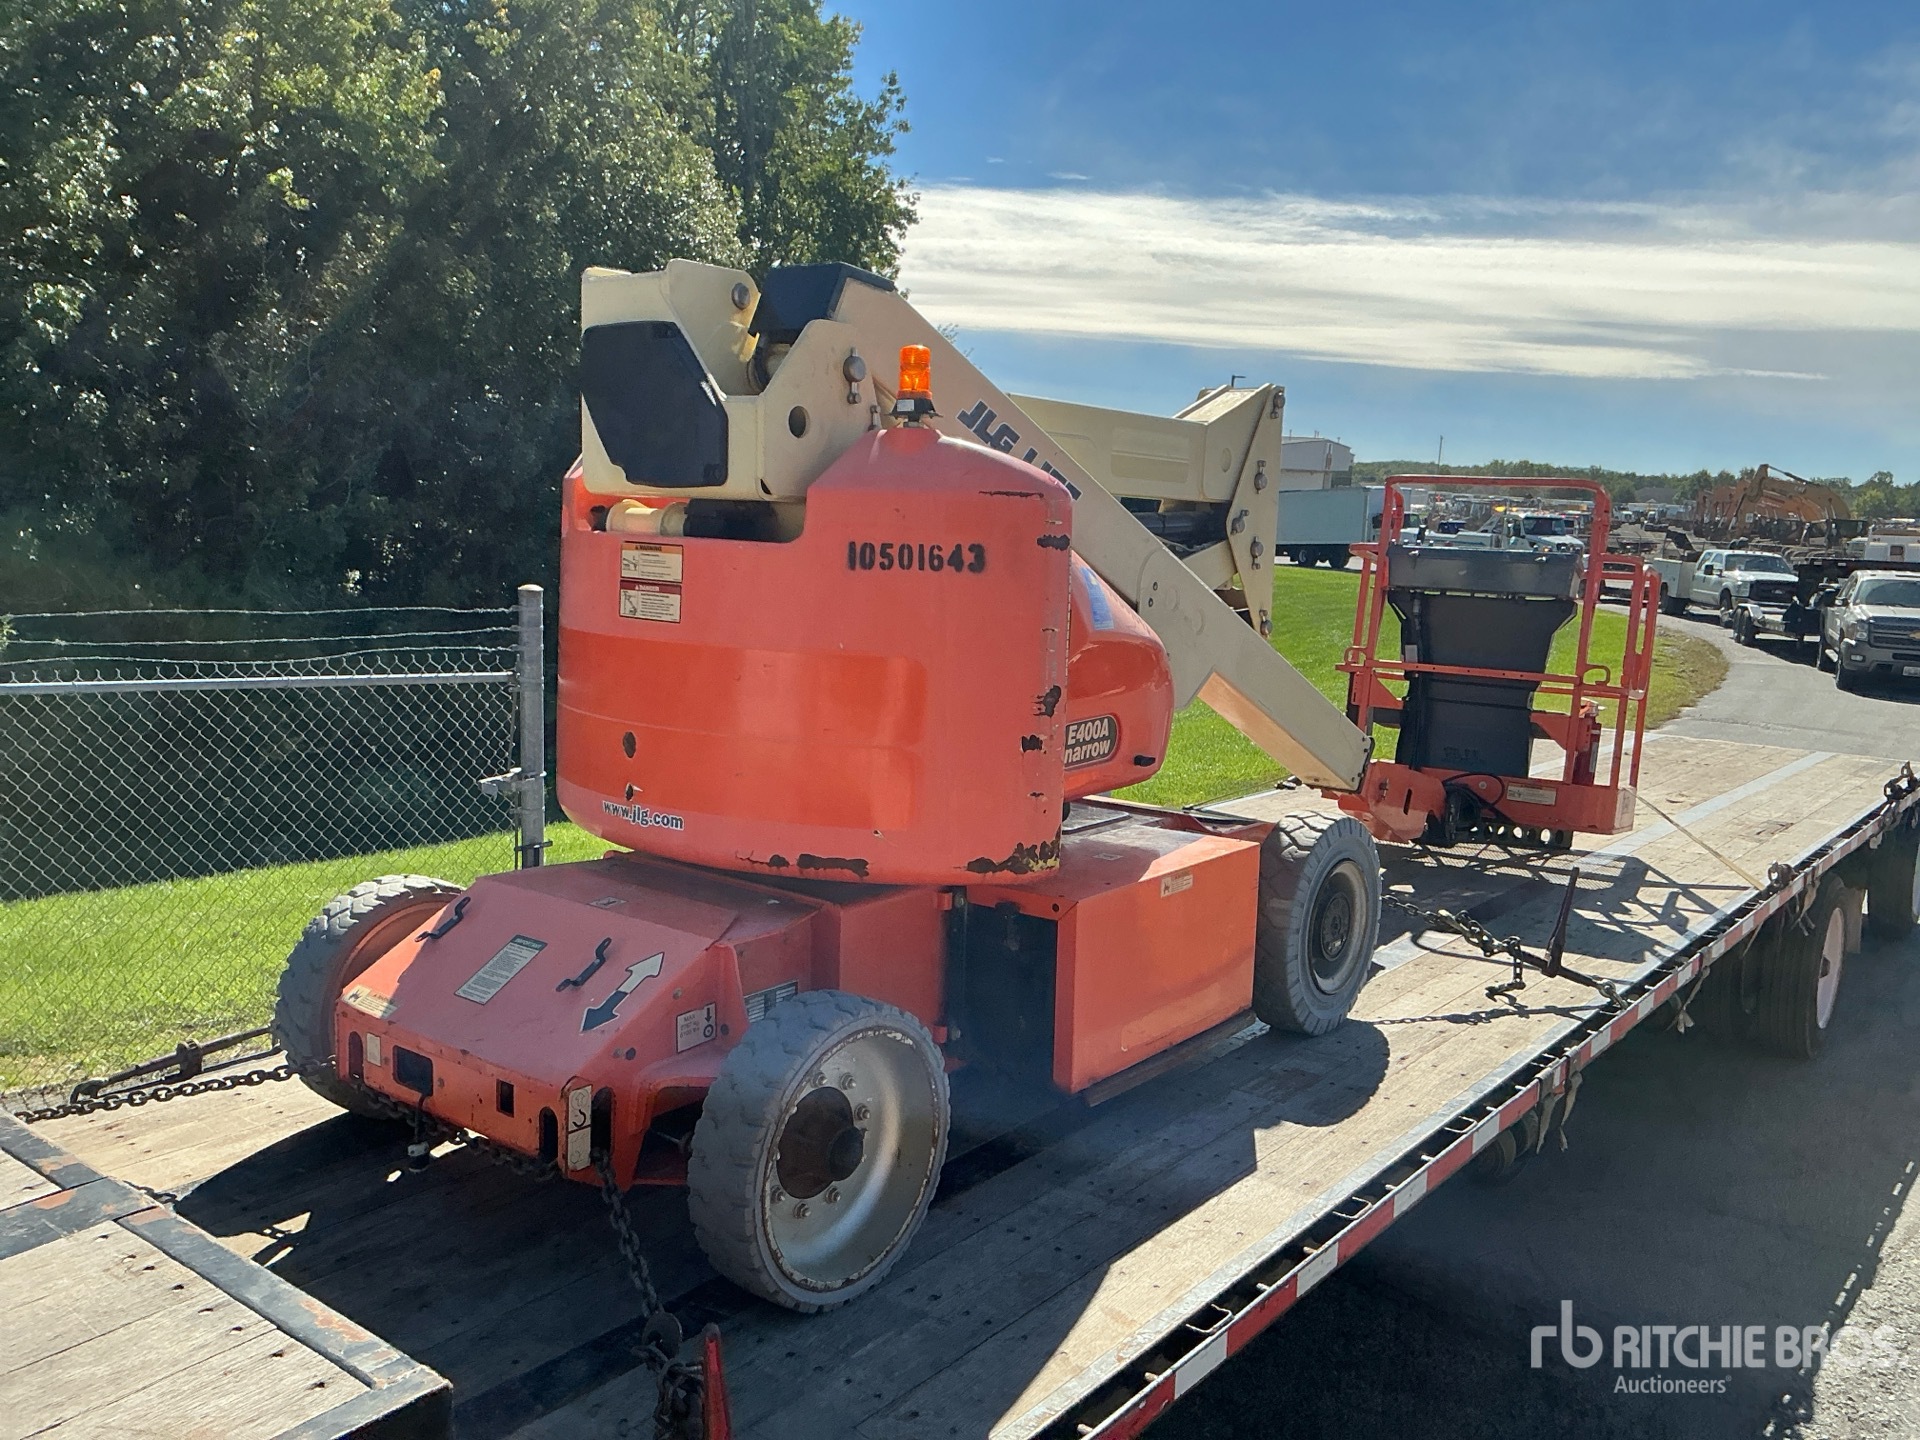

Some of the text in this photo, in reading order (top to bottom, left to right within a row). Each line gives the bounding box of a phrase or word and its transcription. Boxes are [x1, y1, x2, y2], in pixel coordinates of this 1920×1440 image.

[956, 399, 1021, 454] JLG
[847, 540, 986, 573] 10501643
[1067, 718, 1110, 745] E400A
[1064, 739, 1111, 763] narrow
[603, 801, 684, 830] www.jlg.com
